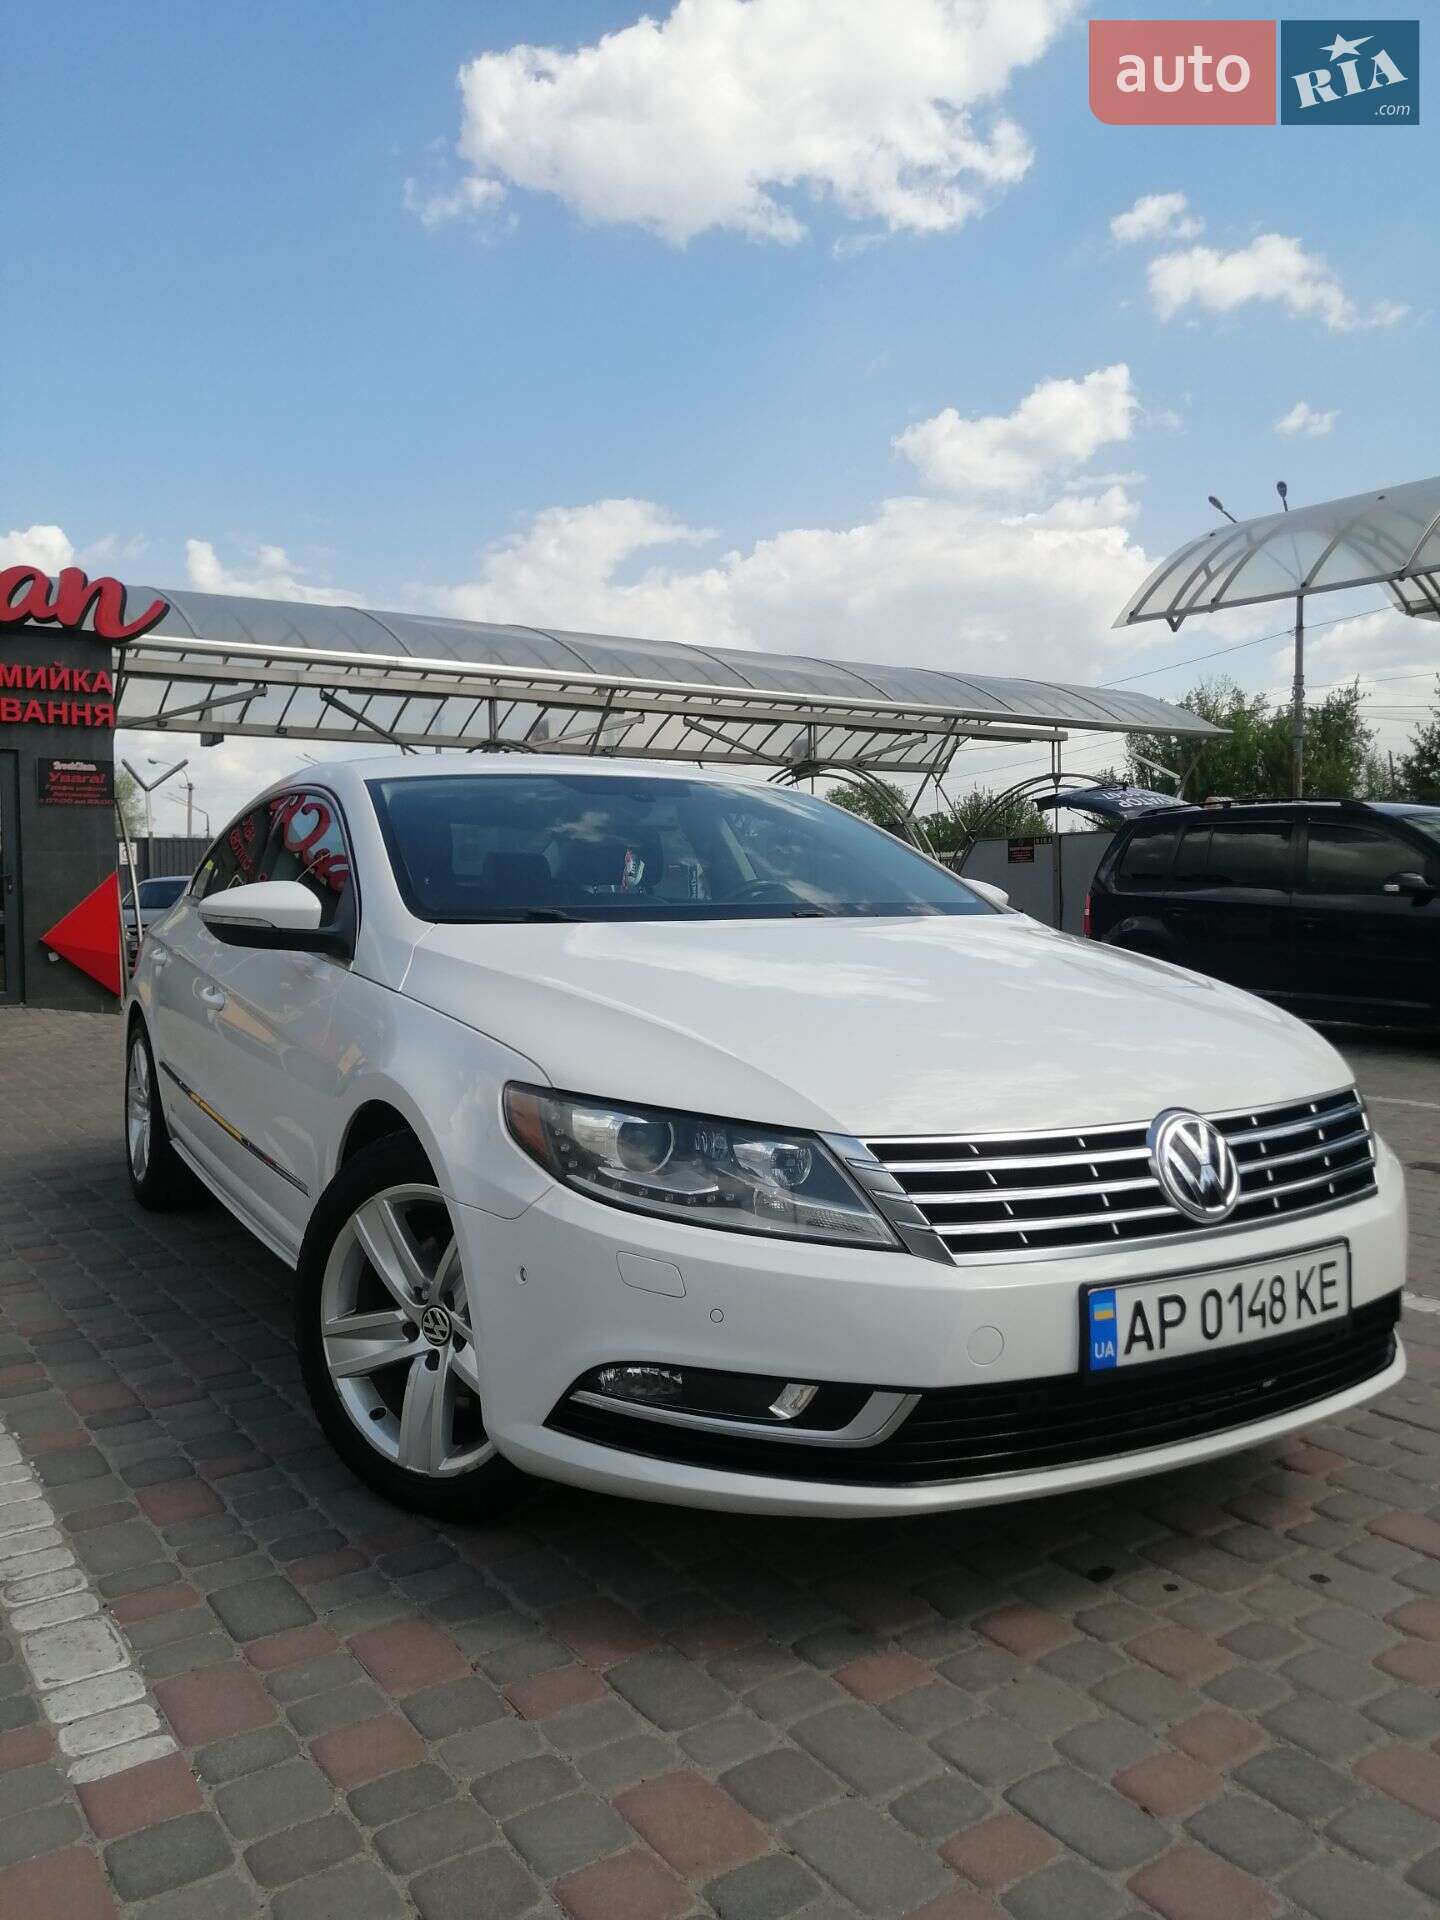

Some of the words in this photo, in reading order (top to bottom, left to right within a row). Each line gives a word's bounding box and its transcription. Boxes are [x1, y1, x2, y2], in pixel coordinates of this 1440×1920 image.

[0, 661, 113, 695] МИЙКА
[0, 696, 116, 729] ВАННЯ
[1124, 1294, 1186, 1355] AP
[1201, 1274, 1287, 1341] 0148
[1296, 1260, 1338, 1320] KE
[1094, 1341, 1115, 1359] UA
